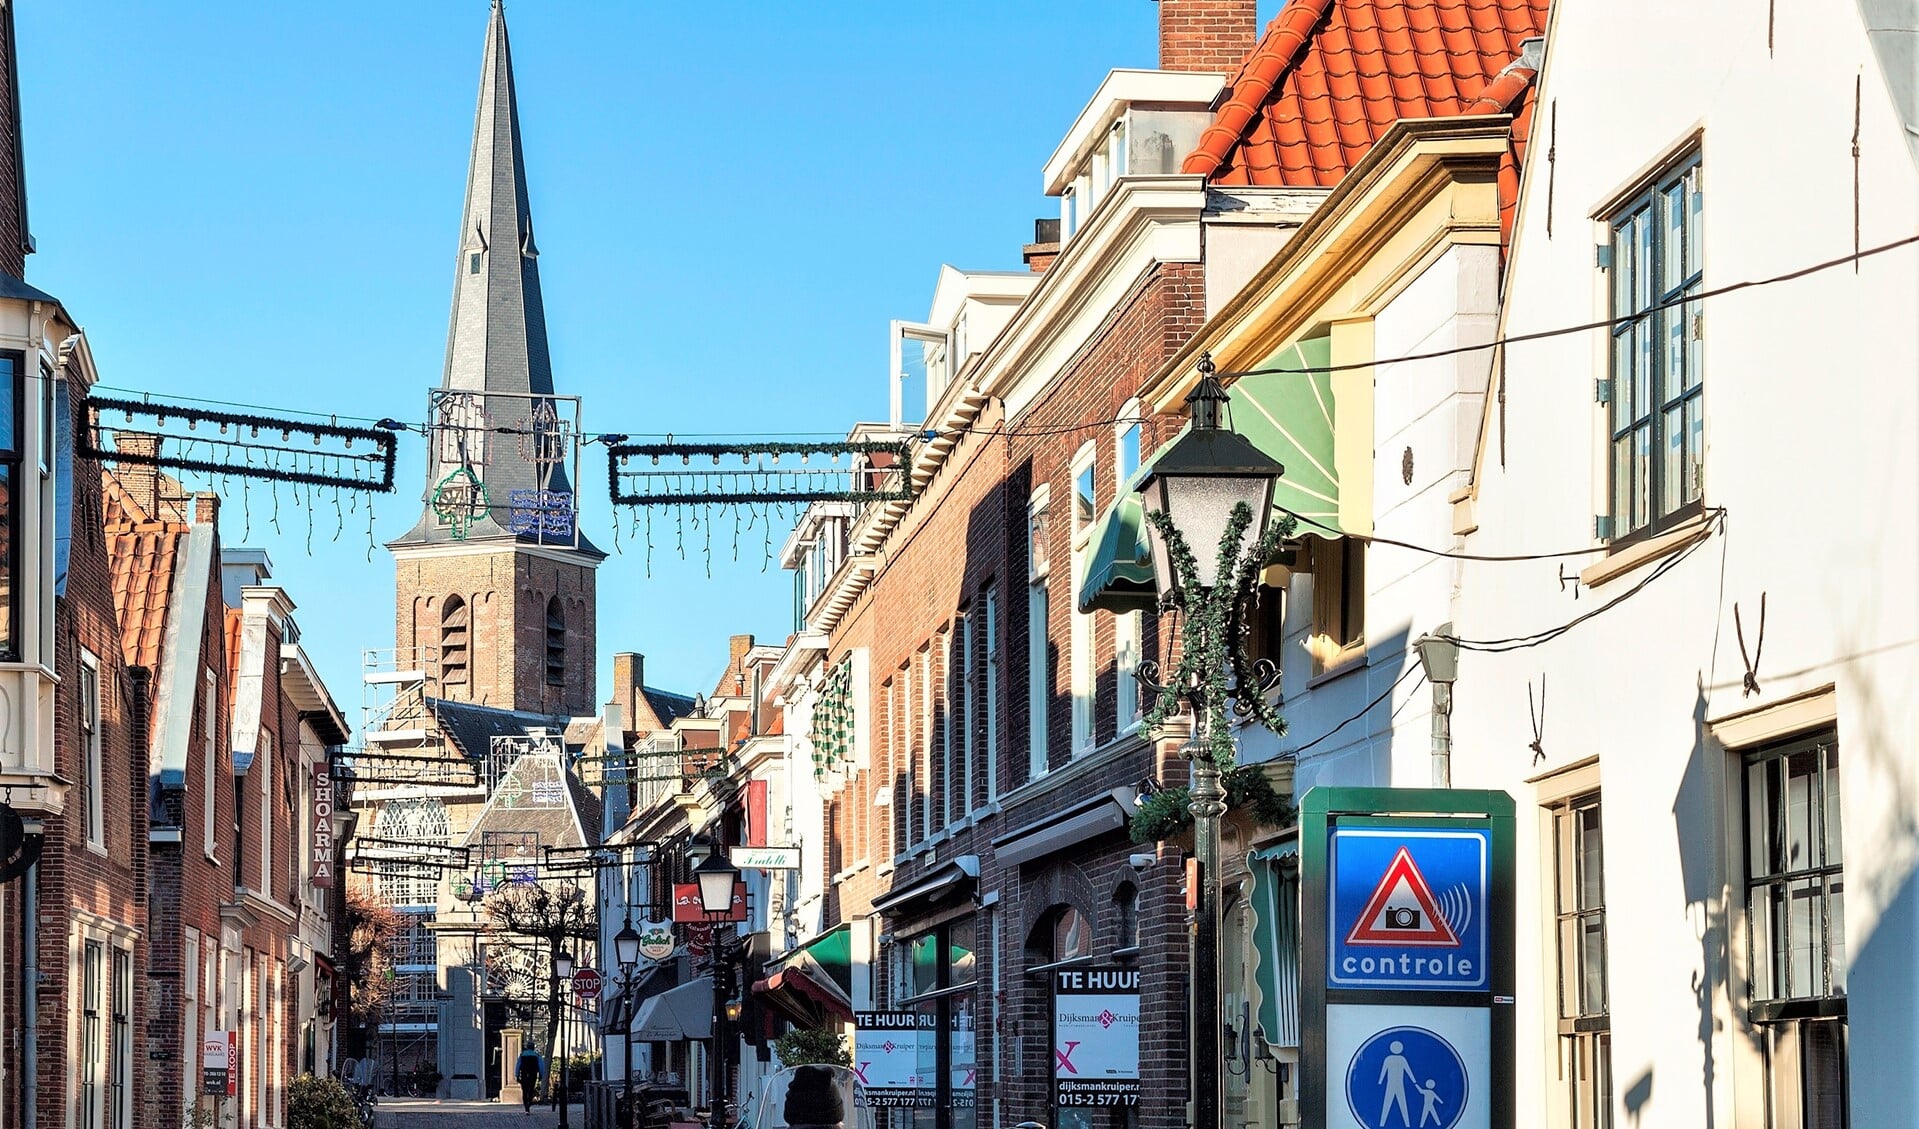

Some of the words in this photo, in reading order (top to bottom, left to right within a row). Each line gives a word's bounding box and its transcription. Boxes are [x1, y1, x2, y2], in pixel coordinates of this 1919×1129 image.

[313, 772, 332, 878] SHOARMA
[1342, 953, 1473, 976] controle
[574, 978, 600, 990] STOP
[1058, 971, 1083, 989] TE
[856, 1014, 873, 1027] TE
[876, 1014, 915, 1027] HUUR
[205, 1044, 223, 1052] WVK
[228, 1043, 236, 1071] KOOP
[228, 1073, 236, 1084] TE
[882, 1097, 899, 1106] 577
[900, 1097, 915, 1106] 177
[1059, 1094, 1094, 1105] 015-2
[1097, 1094, 1120, 1105] 577
[1123, 1094, 1140, 1105] 17
